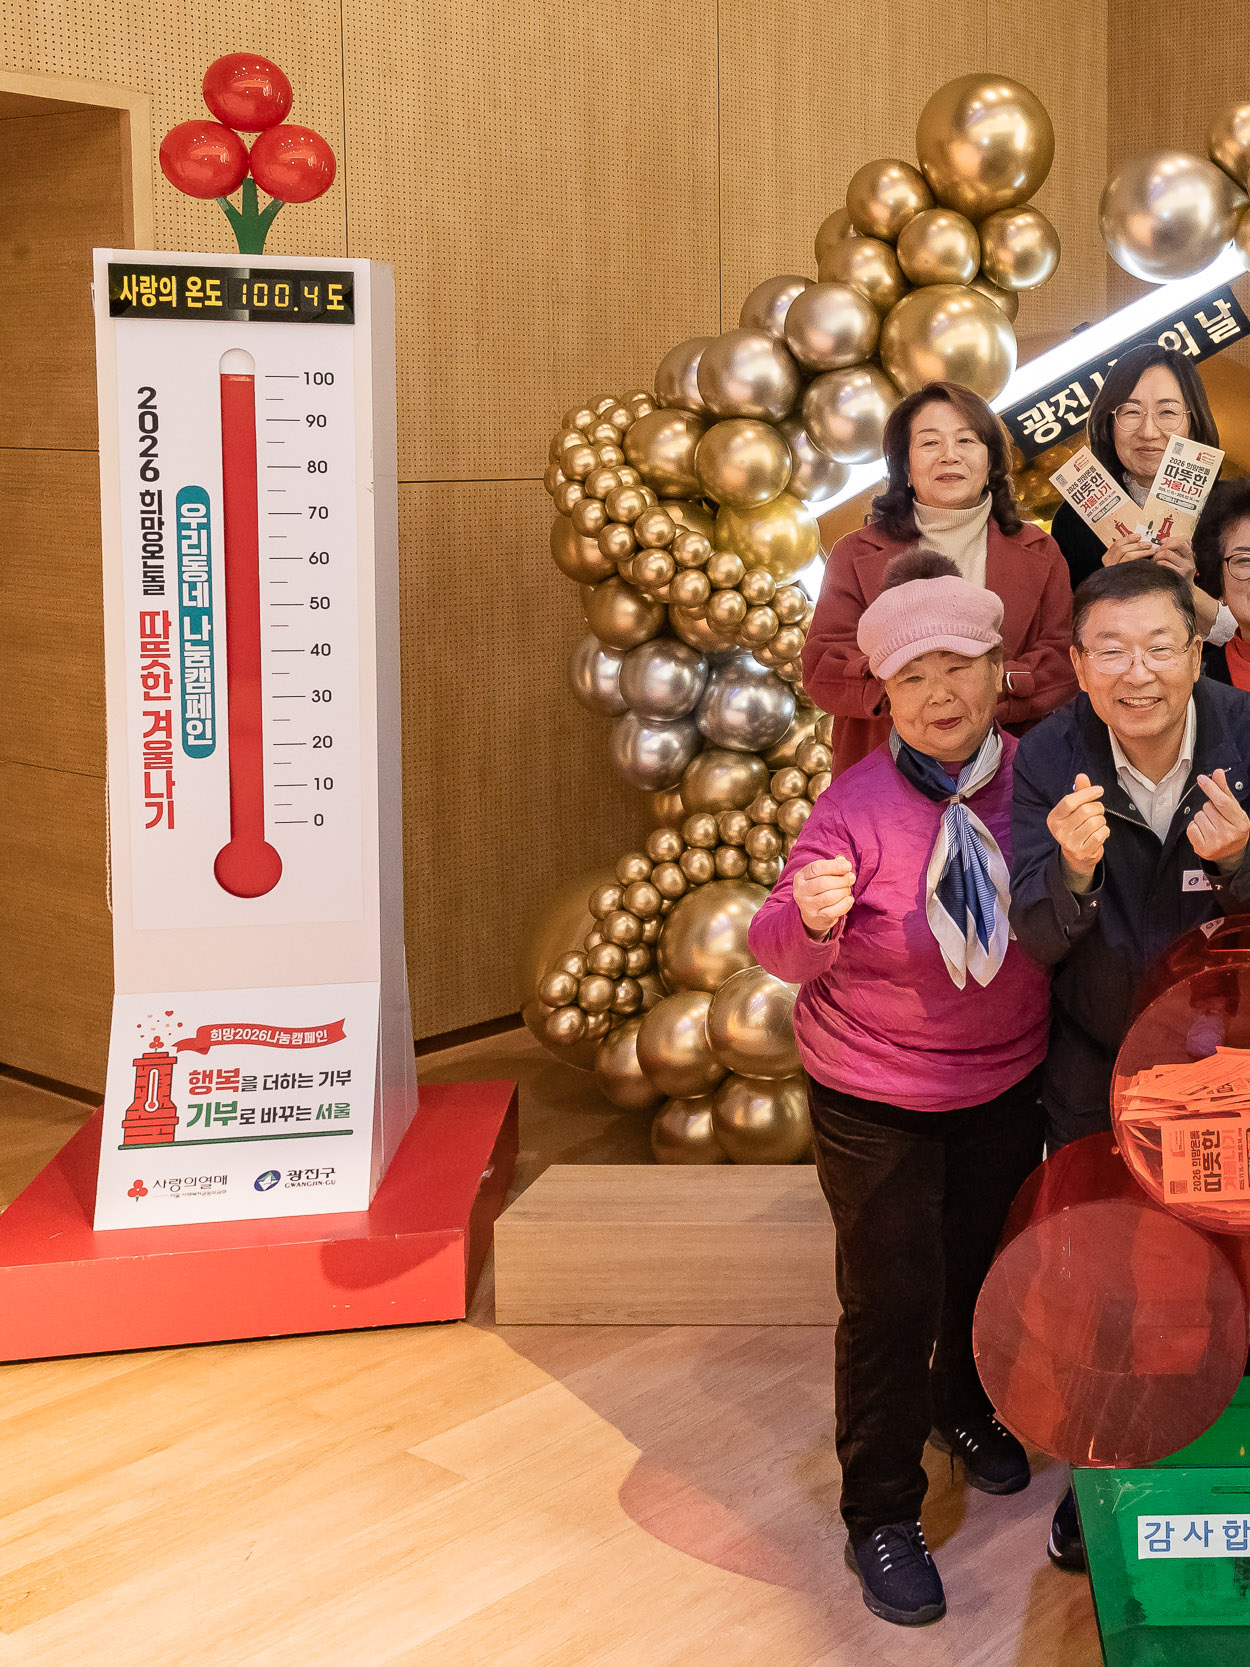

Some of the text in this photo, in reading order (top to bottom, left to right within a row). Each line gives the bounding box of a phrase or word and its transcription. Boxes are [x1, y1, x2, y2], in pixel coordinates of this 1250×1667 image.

[119, 274, 345, 312] 사랑의 온도 100.4 도
[304, 372, 334, 385] 100
[1016, 298, 1241, 446] 광진 날
[306, 415, 326, 427] 90
[308, 461, 327, 473] 80
[1164, 464, 1207, 488] 따뜻한
[1071, 472, 1106, 505] 따뜻한
[309, 506, 328, 519] 70
[309, 552, 329, 564] 60
[137, 386, 176, 829] 2026 희망온돌 따뜻한 겨울나기
[310, 597, 330, 609] 50
[179, 503, 213, 746] 우리동네 나눔캠페인
[311, 643, 331, 656] 40
[312, 690, 331, 702] 30
[313, 736, 332, 748] 20
[315, 777, 333, 790] 10
[314, 814, 323, 826] 0
[210, 1028, 328, 1045] 희망2026나눔캠페인
[188, 1068, 352, 1095] 행복을 더하는 기부
[186, 1101, 351, 1128] 기부로 바꾸는 서울
[1201, 1129, 1222, 1192] 따뜻한
[286, 1167, 336, 1181] 광진구
[1192, 1169, 1202, 1192] 2026
[152, 1174, 229, 1193] 사랑의열매
